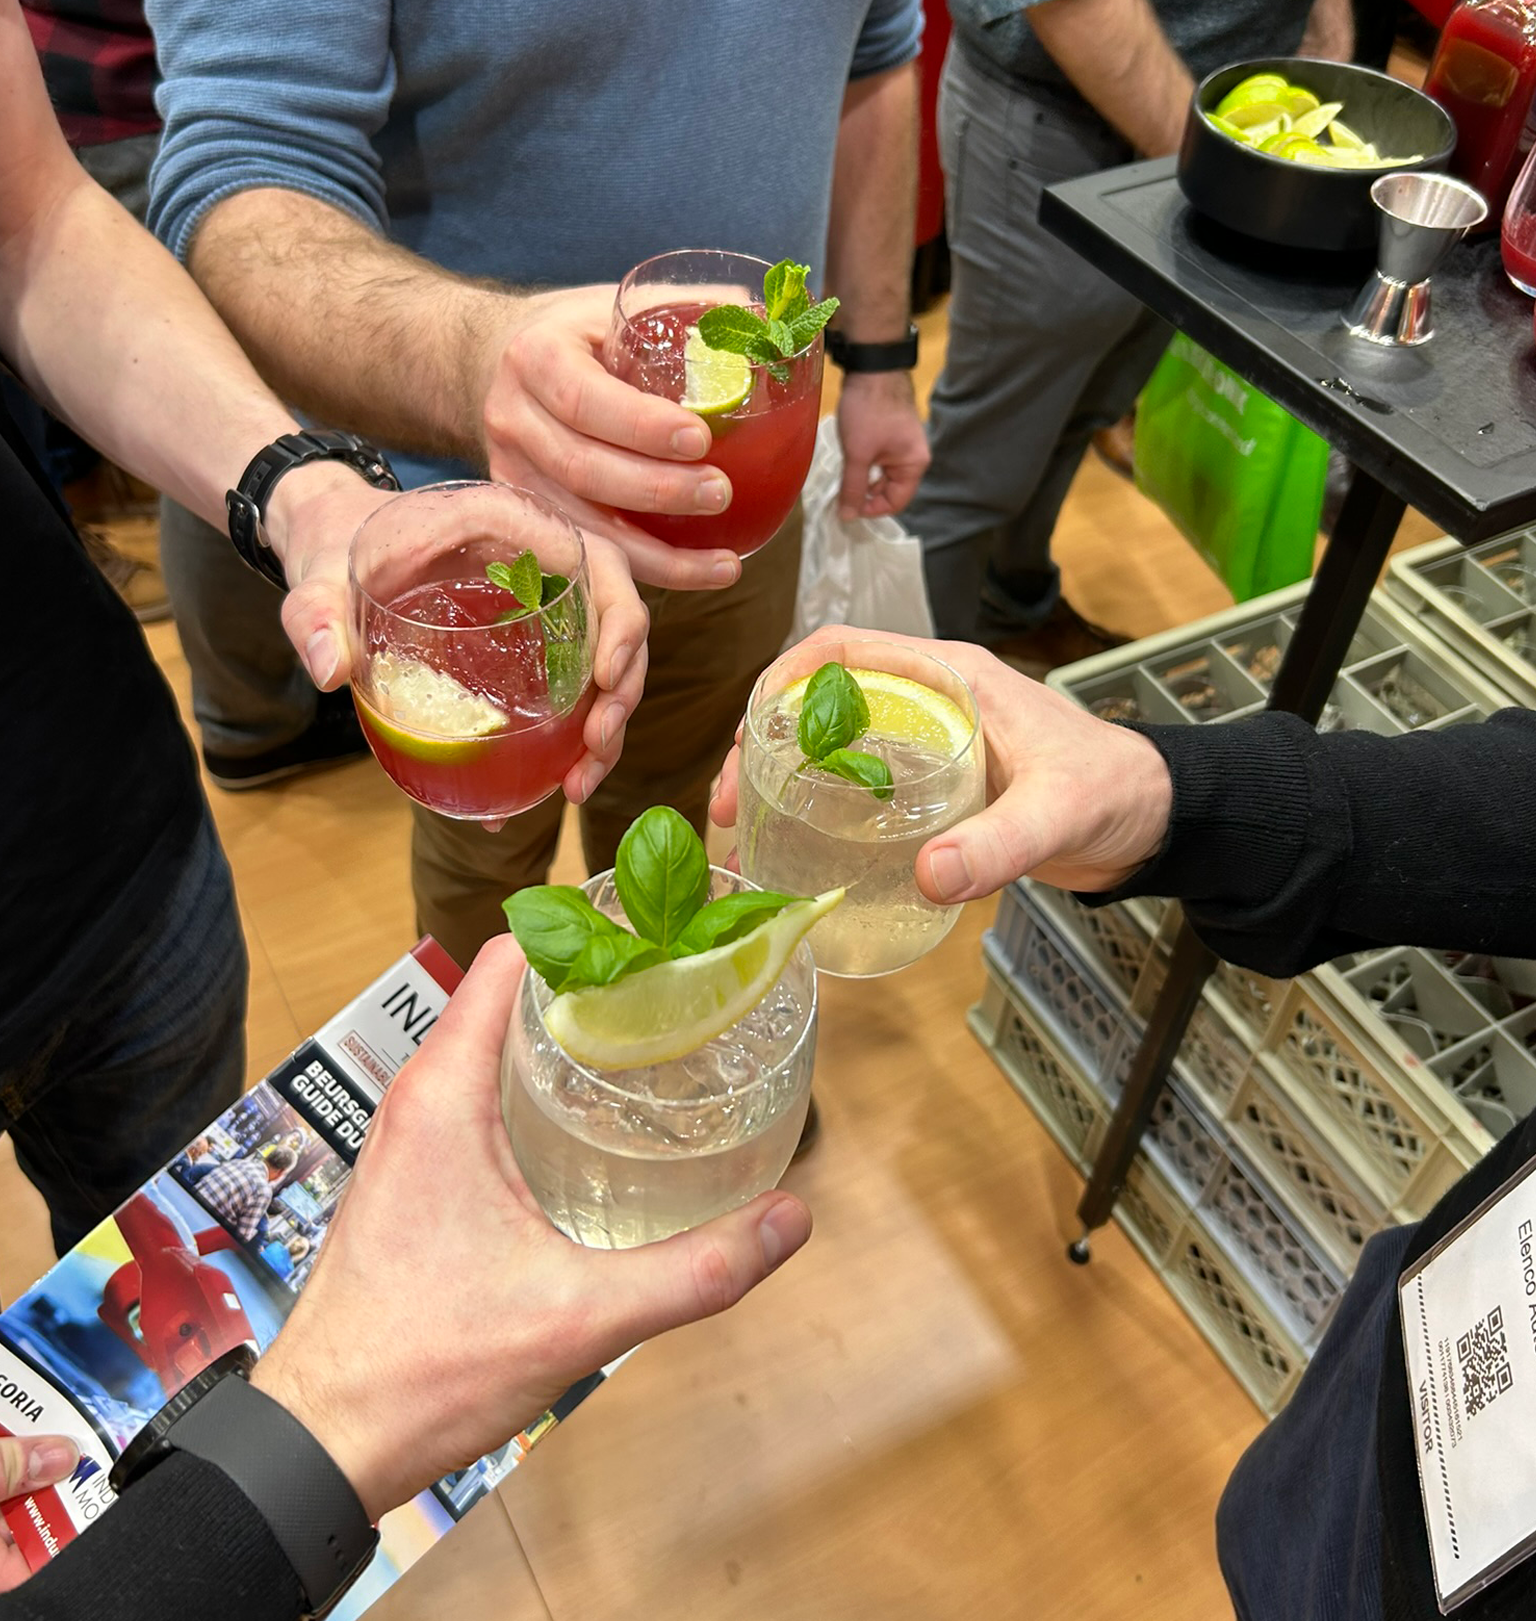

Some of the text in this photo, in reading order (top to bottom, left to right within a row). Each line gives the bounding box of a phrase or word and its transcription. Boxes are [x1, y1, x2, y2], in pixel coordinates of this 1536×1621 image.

[291, 1074, 365, 1149] GUIDE DU
[1518, 1219, 1536, 1296] Elenco
[1418, 1380, 1435, 1454] VISITOR
[75, 1489, 99, 1519] MO
